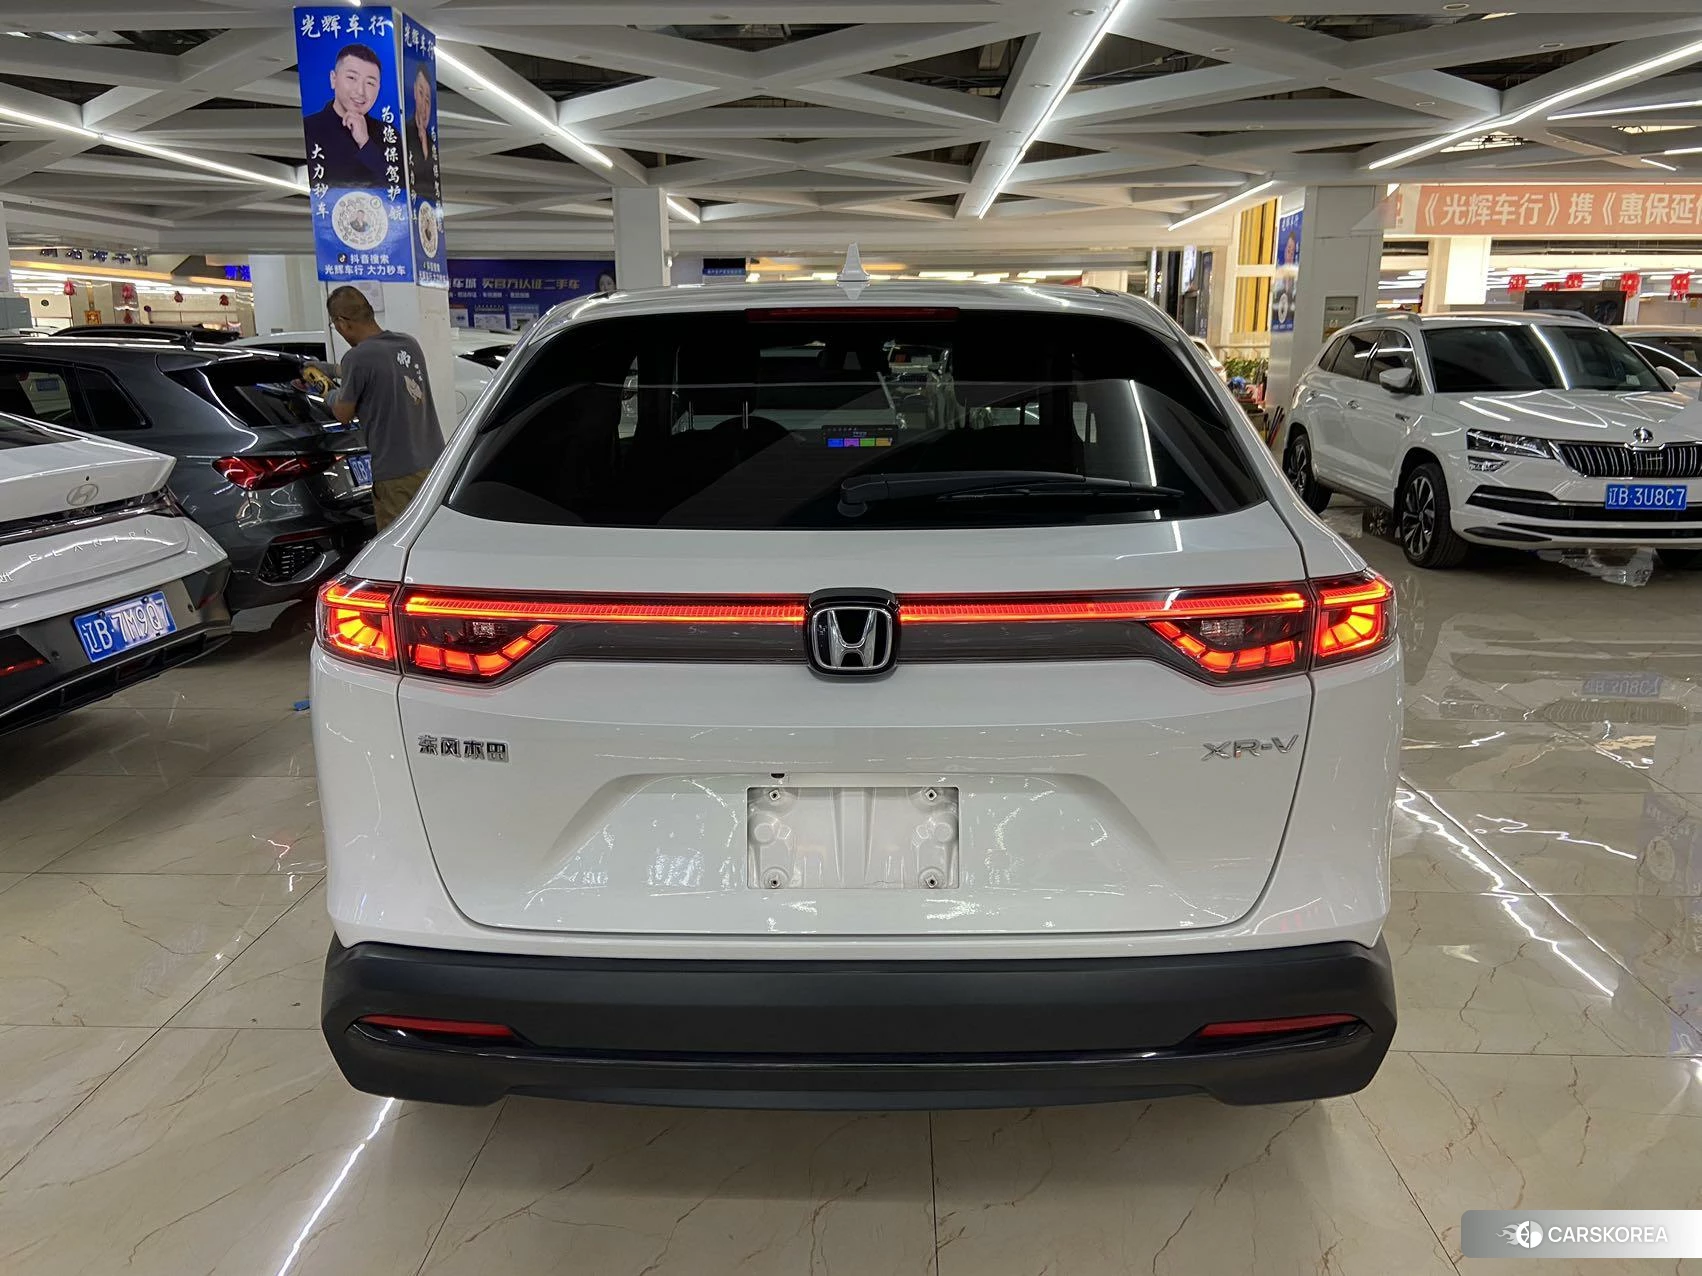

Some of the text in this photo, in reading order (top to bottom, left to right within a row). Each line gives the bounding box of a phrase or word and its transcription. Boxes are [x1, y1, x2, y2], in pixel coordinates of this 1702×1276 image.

[301, 14, 394, 39] 光辉车行
[1425, 192, 1702, 226] 《光辉车行》携《惠保延
[418, 735, 509, 763] 东风本田
[1201, 734, 1299, 761] XR-V
